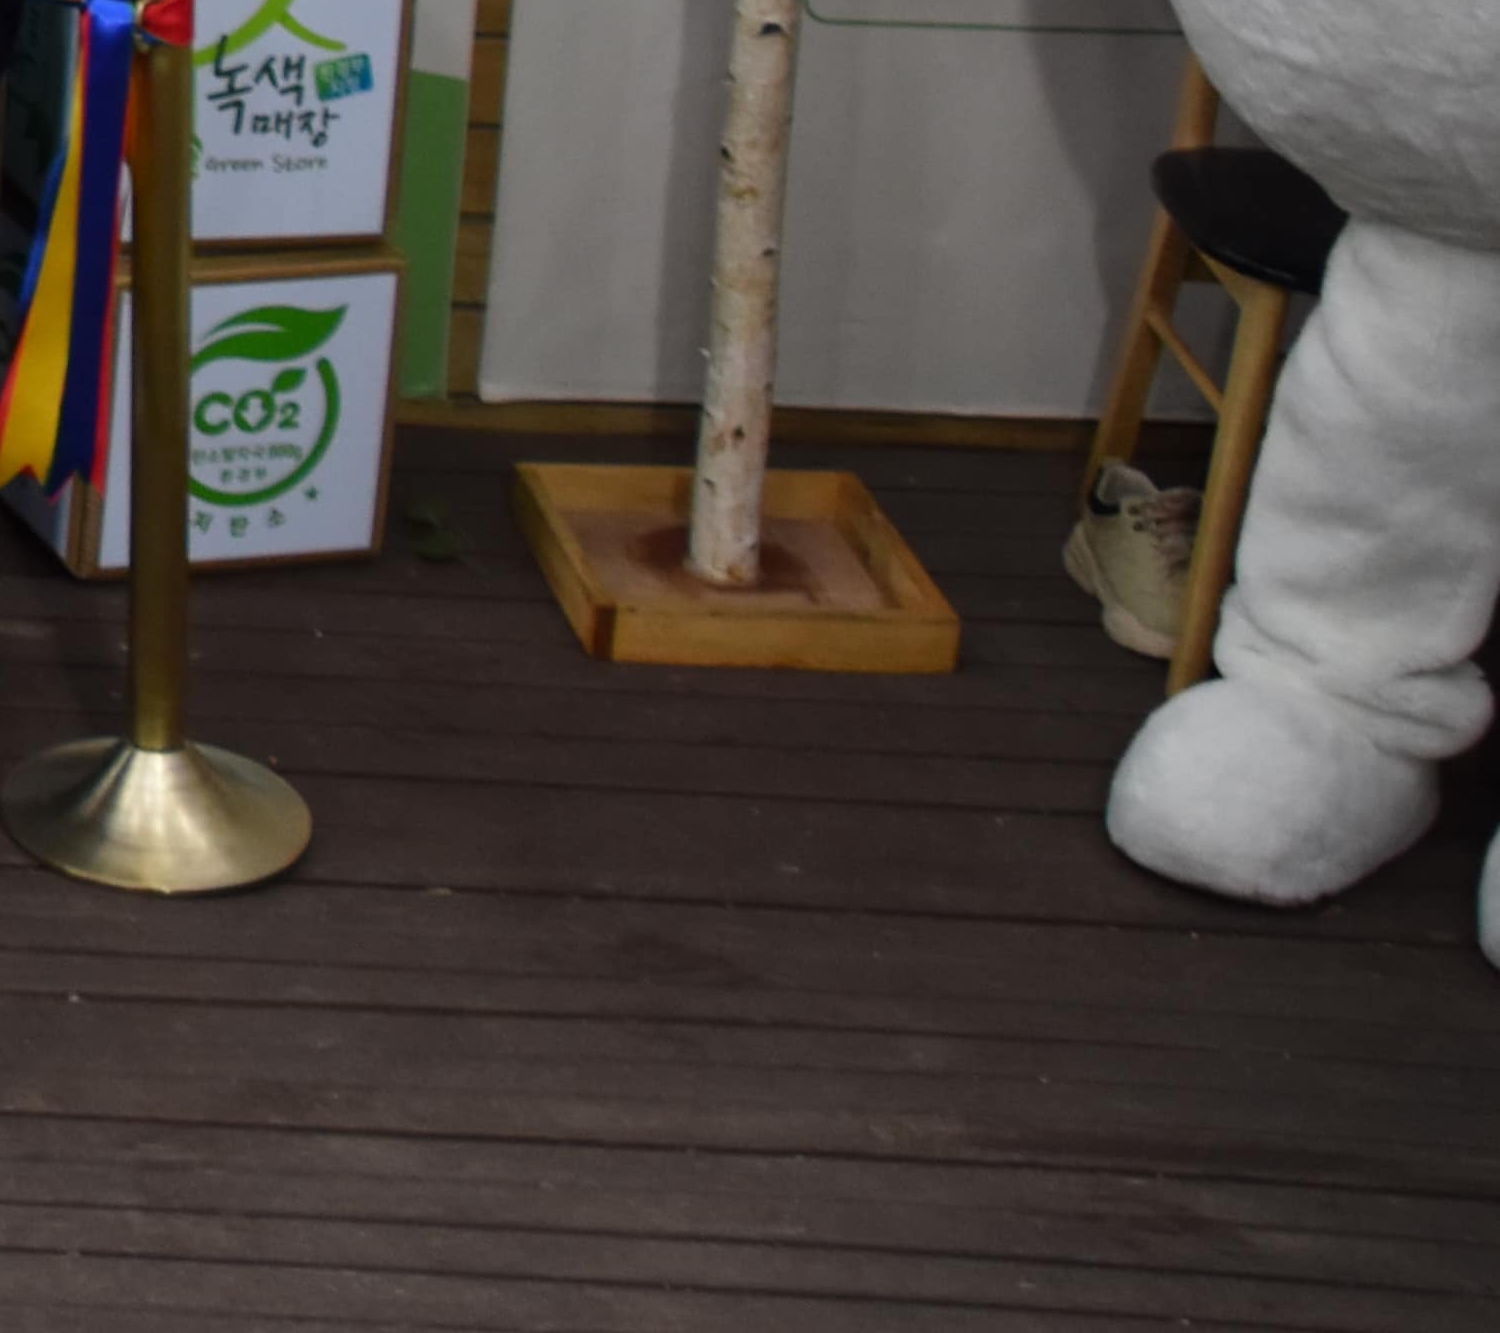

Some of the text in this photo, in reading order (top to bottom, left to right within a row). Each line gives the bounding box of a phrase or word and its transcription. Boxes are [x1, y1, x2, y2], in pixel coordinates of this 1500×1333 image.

[206, 33, 307, 136] 녹색
[251, 106, 341, 149] 매장
[270, 153, 330, 175] Store
[194, 387, 302, 437] CO2
